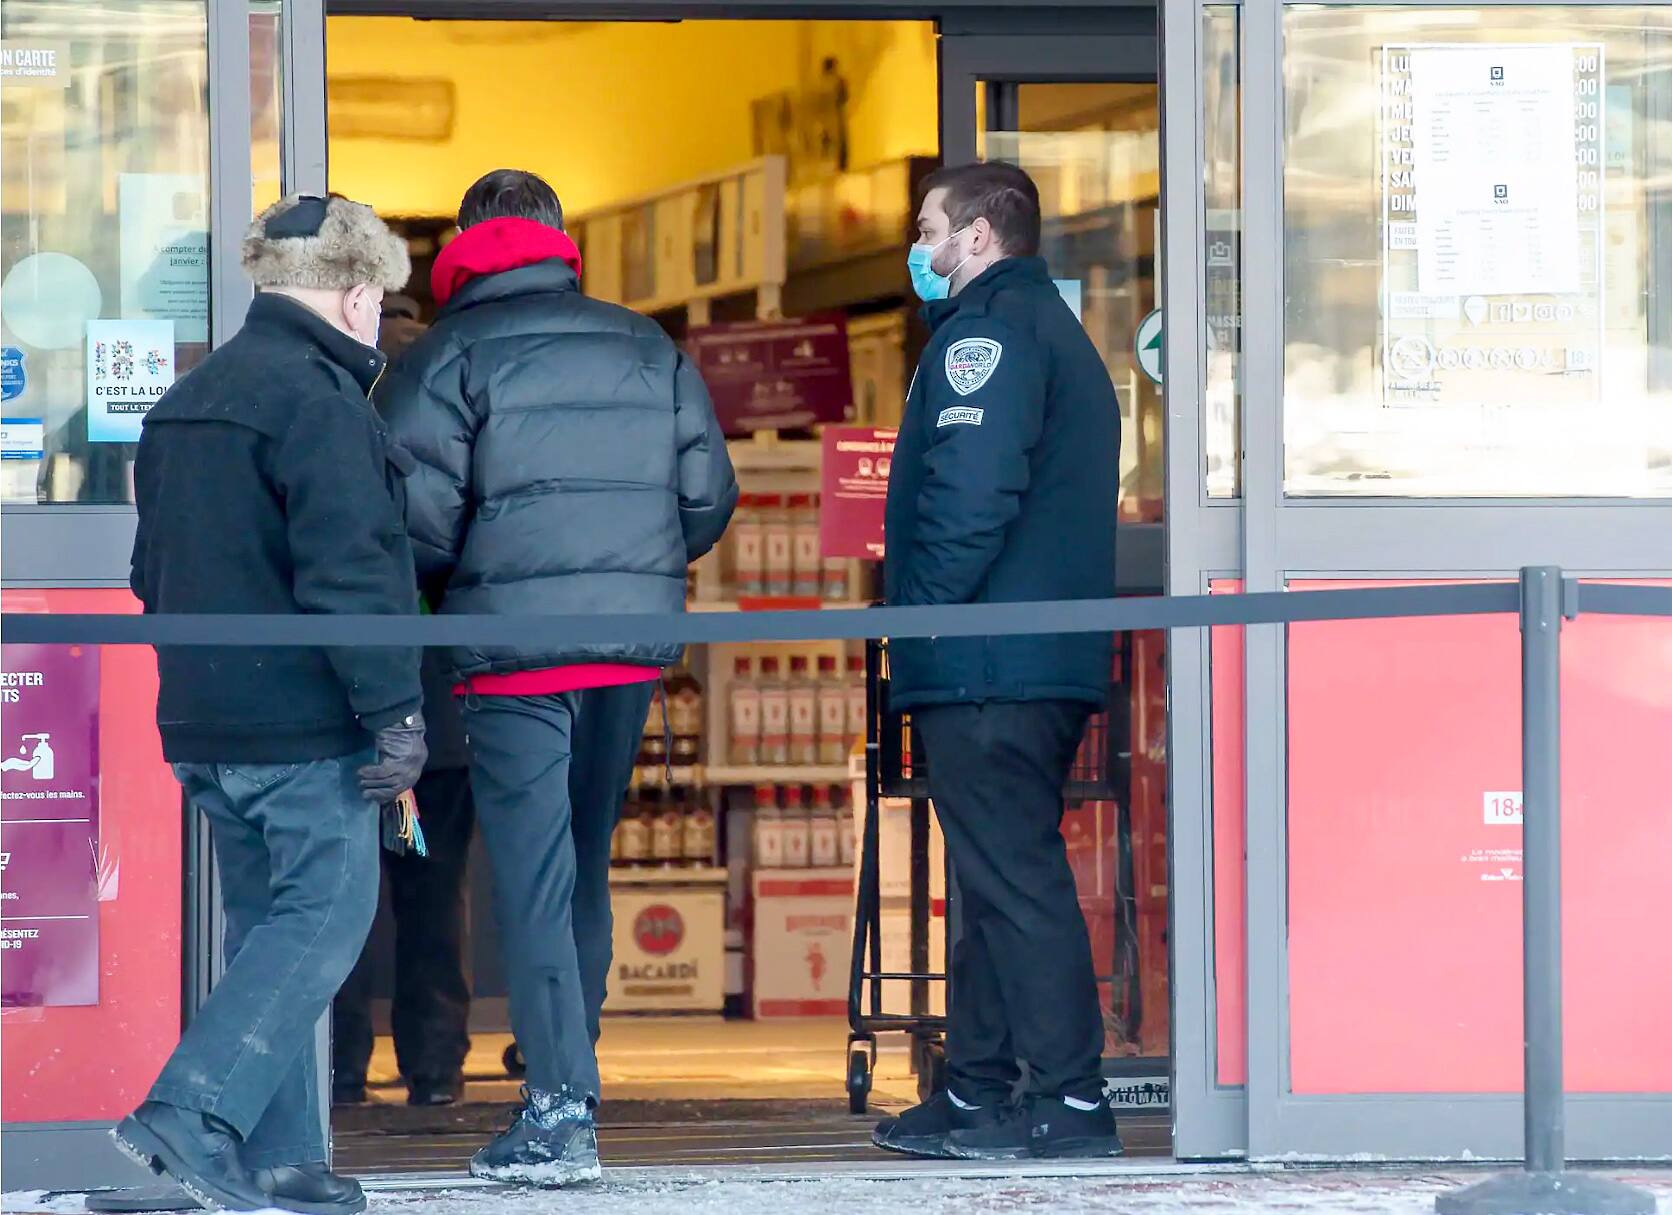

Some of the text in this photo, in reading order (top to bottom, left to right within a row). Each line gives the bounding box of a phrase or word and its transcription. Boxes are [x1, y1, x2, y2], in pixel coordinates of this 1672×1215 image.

[15, 49, 56, 67] CARTE
[170, 256, 199, 266] janvier
[96, 386, 128, 396] C'EST
[131, 386, 146, 396] LA
[941, 411, 979, 421] SÉCURITÉ
[46, 790, 58, 799] les
[59, 790, 86, 799] mains.
[619, 958, 698, 980] BACARDÍ
